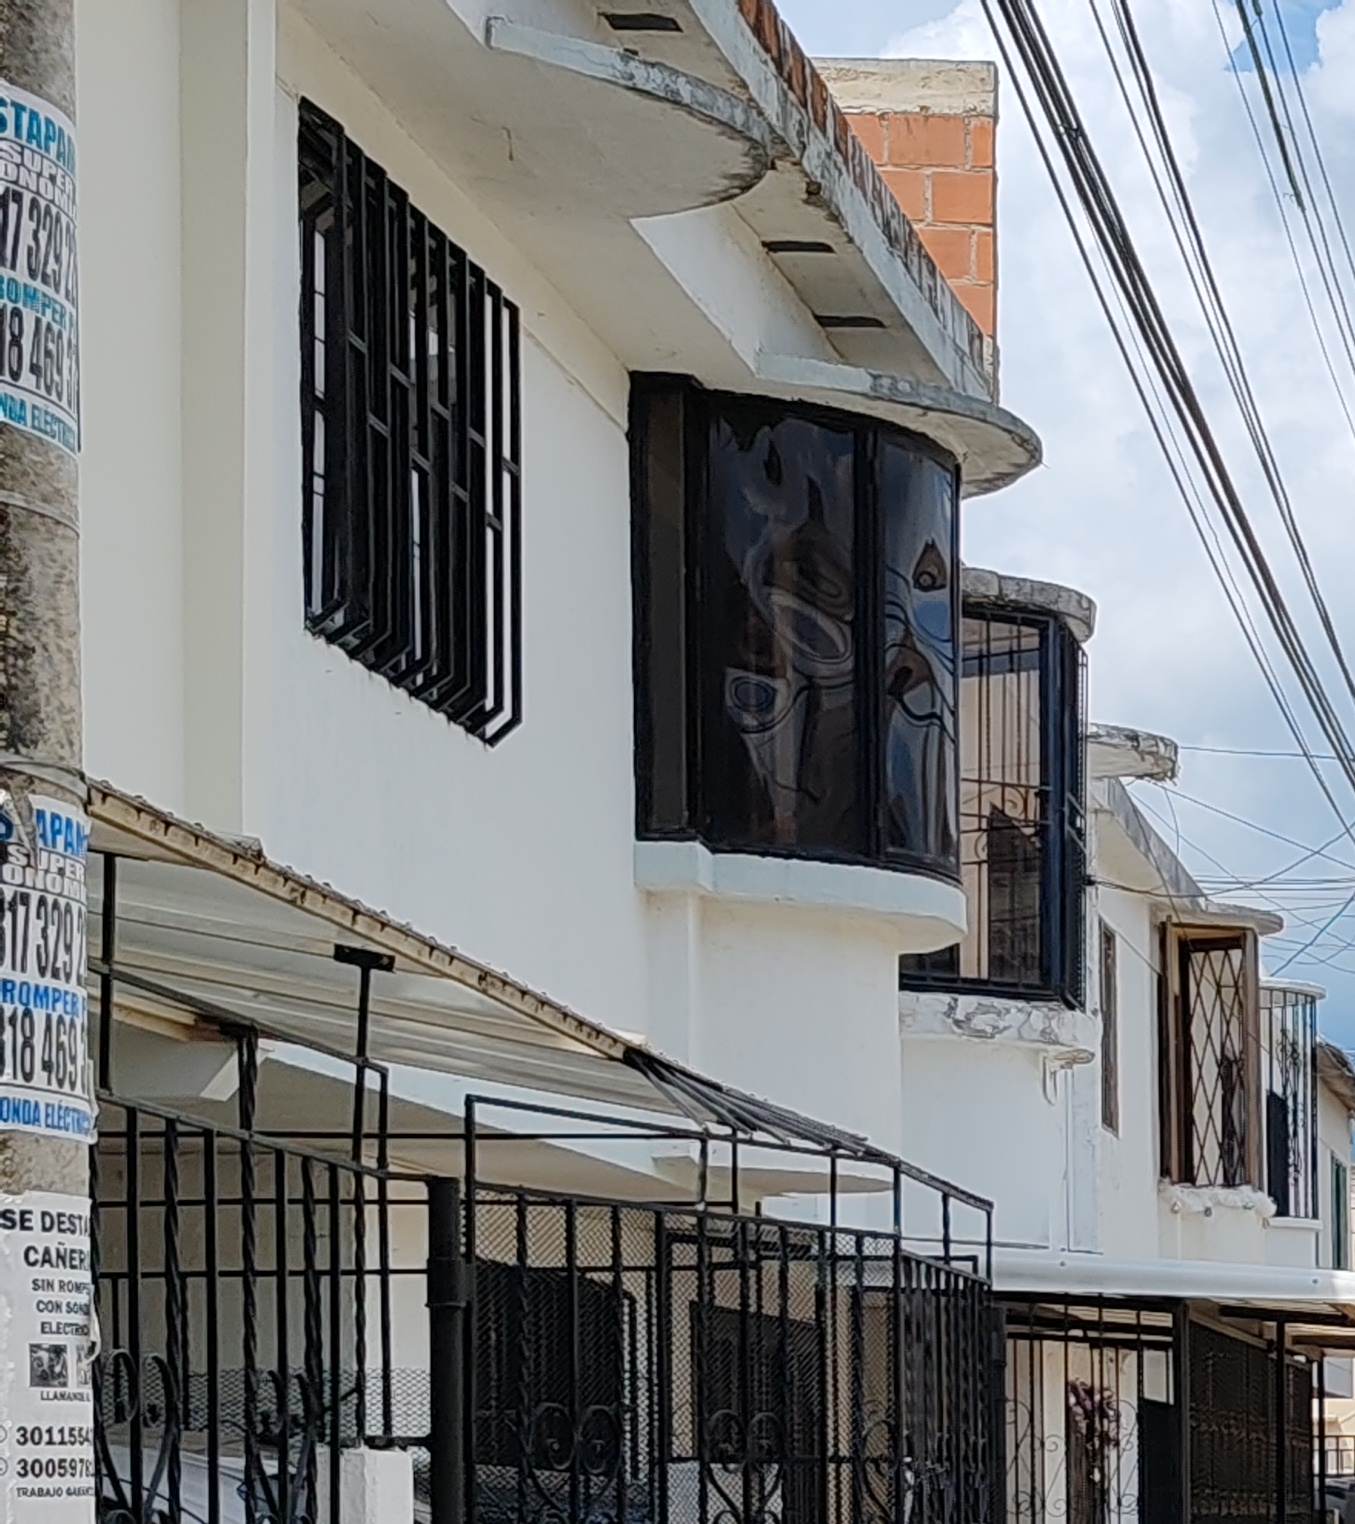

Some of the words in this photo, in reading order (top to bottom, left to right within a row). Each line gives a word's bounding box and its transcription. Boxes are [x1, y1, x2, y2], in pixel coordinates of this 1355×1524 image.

[36, 894, 73, 985] 329
[41, 1012, 78, 1092] 469
[0, 1209, 34, 1232] SE
[31, 1278, 55, 1292] SIN
[36, 1300, 62, 1314] CON
[16, 1486, 62, 1498] TRABAJO
